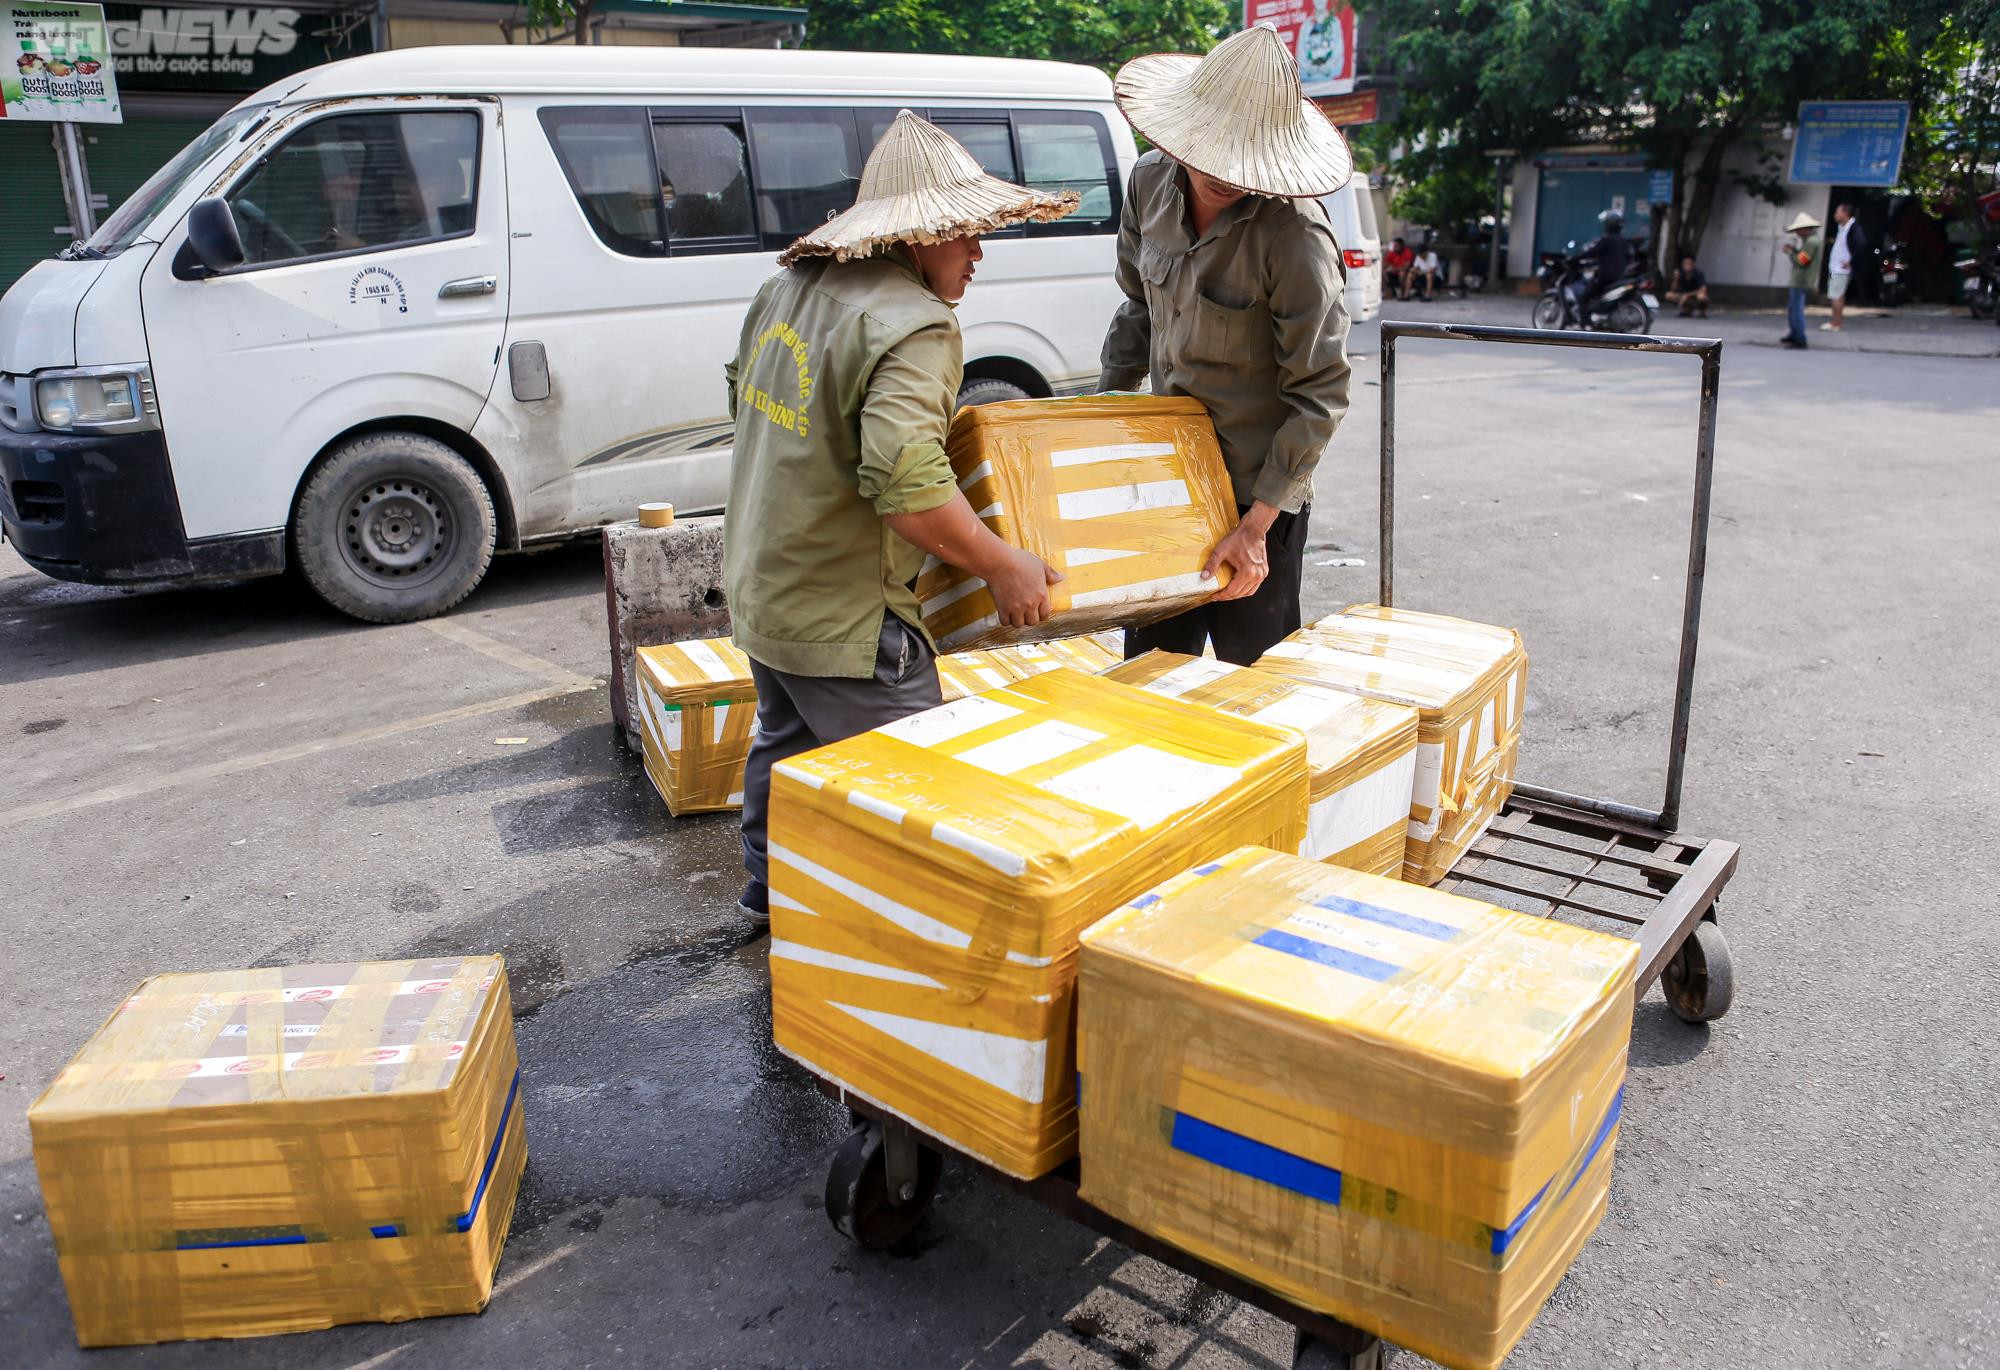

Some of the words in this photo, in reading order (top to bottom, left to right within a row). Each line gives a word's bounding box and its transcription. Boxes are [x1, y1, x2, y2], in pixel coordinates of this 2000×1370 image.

[12, 9, 80, 17] Nutriboost
[51, 82, 77, 90] nutri
[52, 89, 79, 97] boost
